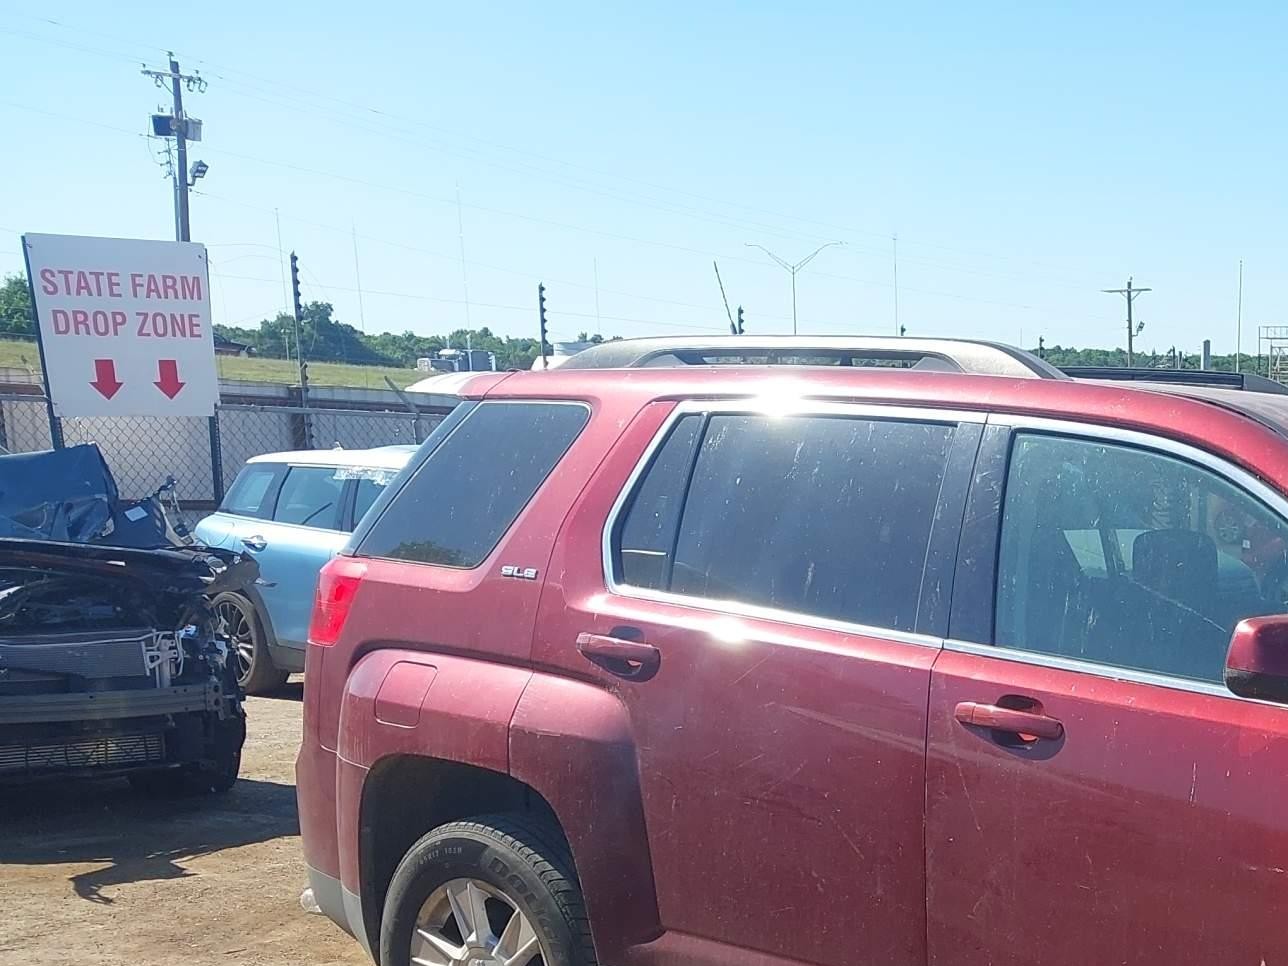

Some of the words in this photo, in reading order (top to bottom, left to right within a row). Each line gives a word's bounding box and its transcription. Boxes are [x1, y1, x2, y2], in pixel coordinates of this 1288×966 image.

[40, 268, 122, 298] STATE
[130, 273, 202, 301] FARM
[51, 309, 127, 337] DROP
[135, 311, 202, 339] ZONE
[501, 565, 537, 578] SLE
